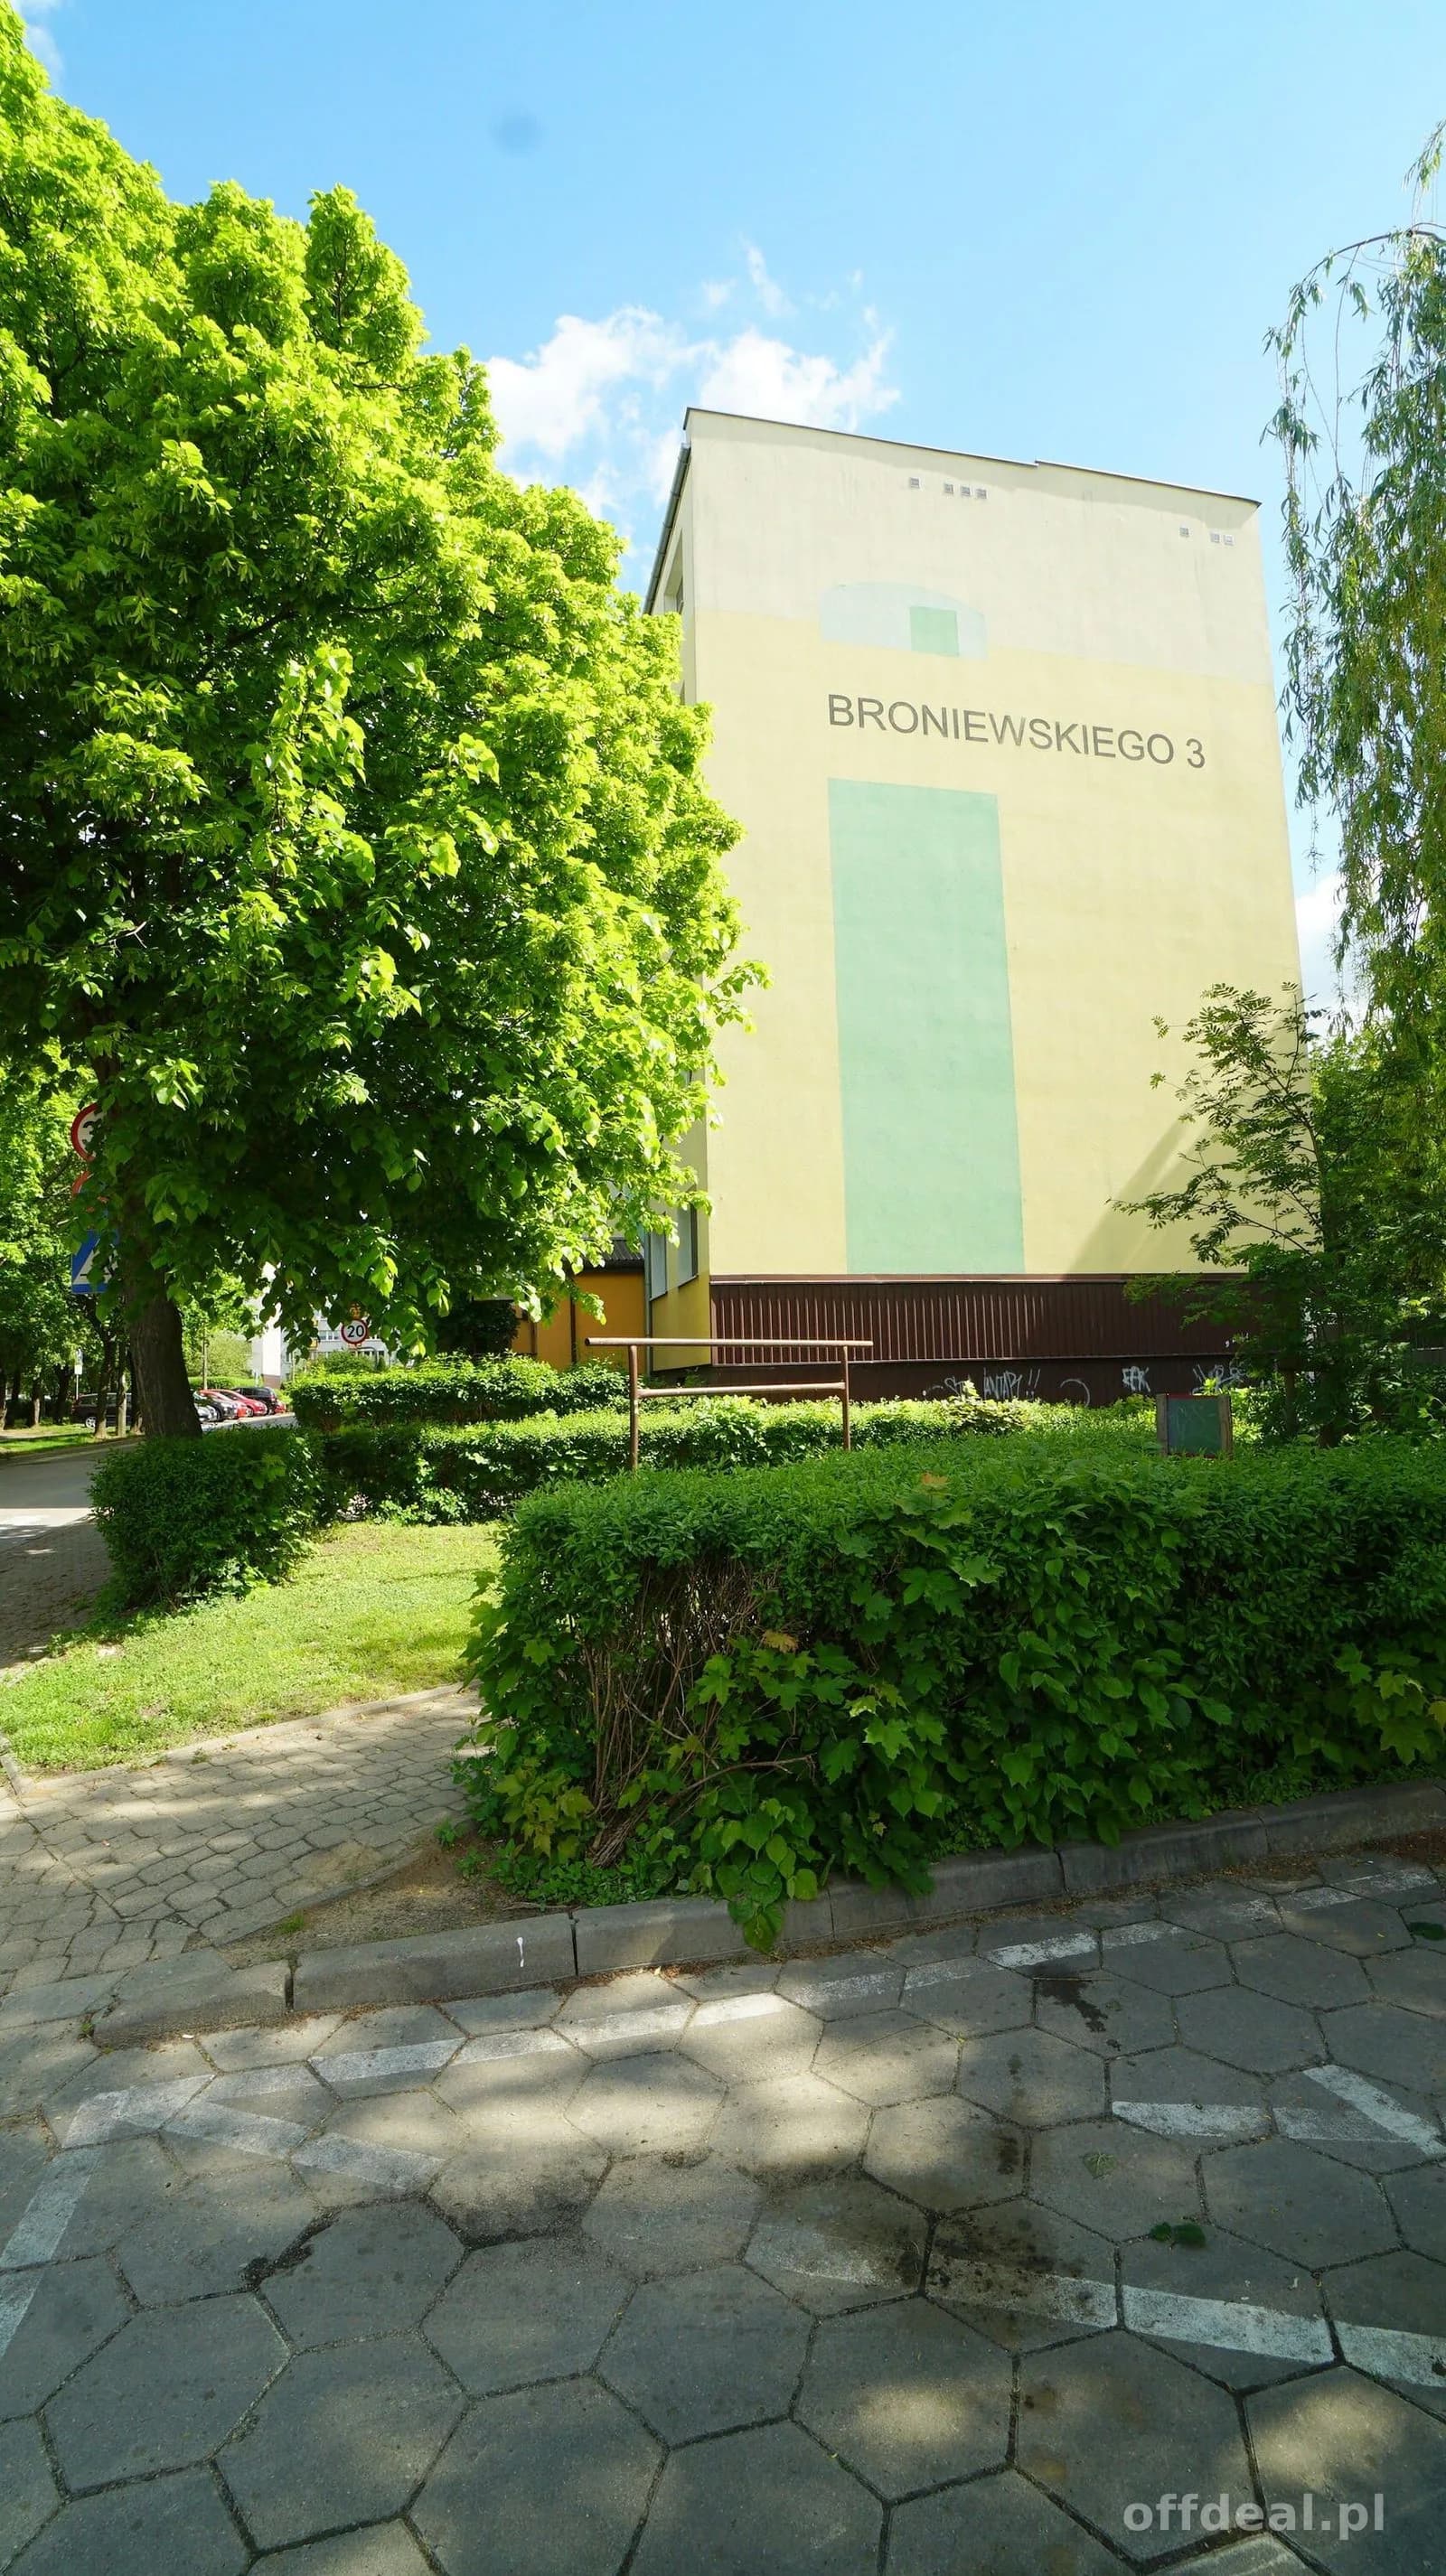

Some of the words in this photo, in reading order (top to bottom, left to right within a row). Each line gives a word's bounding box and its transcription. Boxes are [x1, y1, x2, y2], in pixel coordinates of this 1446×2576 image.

[828, 693, 1175, 765] BRONIEWSKIEGO
[1186, 737, 1206, 769] 3
[347, 1325, 364, 1338] 20
